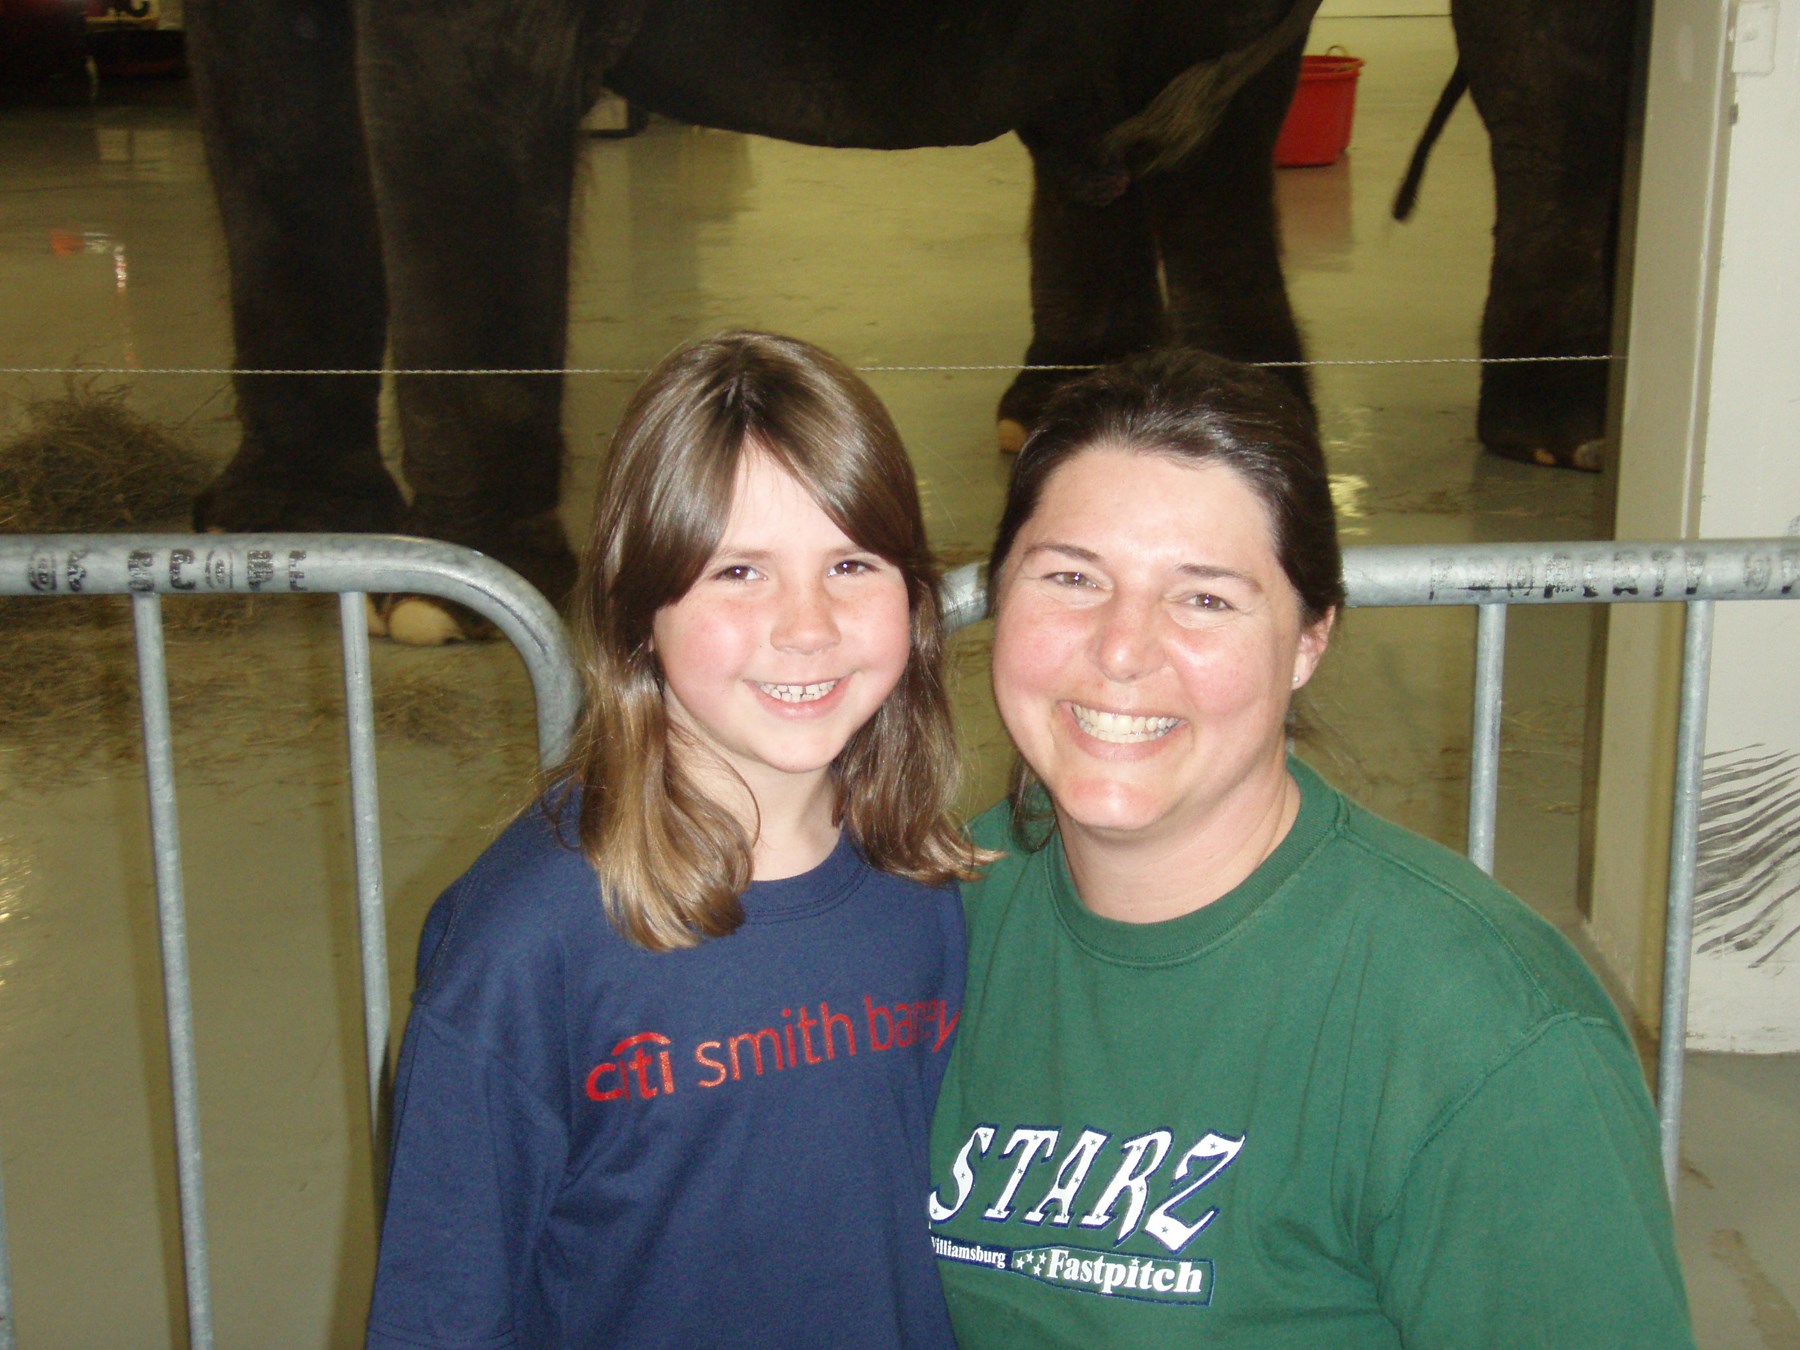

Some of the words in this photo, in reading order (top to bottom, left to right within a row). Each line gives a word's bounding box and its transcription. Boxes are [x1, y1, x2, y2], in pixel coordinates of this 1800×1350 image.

[585, 1031, 675, 1101] citi
[695, 1001, 857, 1088] smith
[929, 1123, 1247, 1255] STARZ
[1047, 1249, 1202, 1293] Fastpitch
